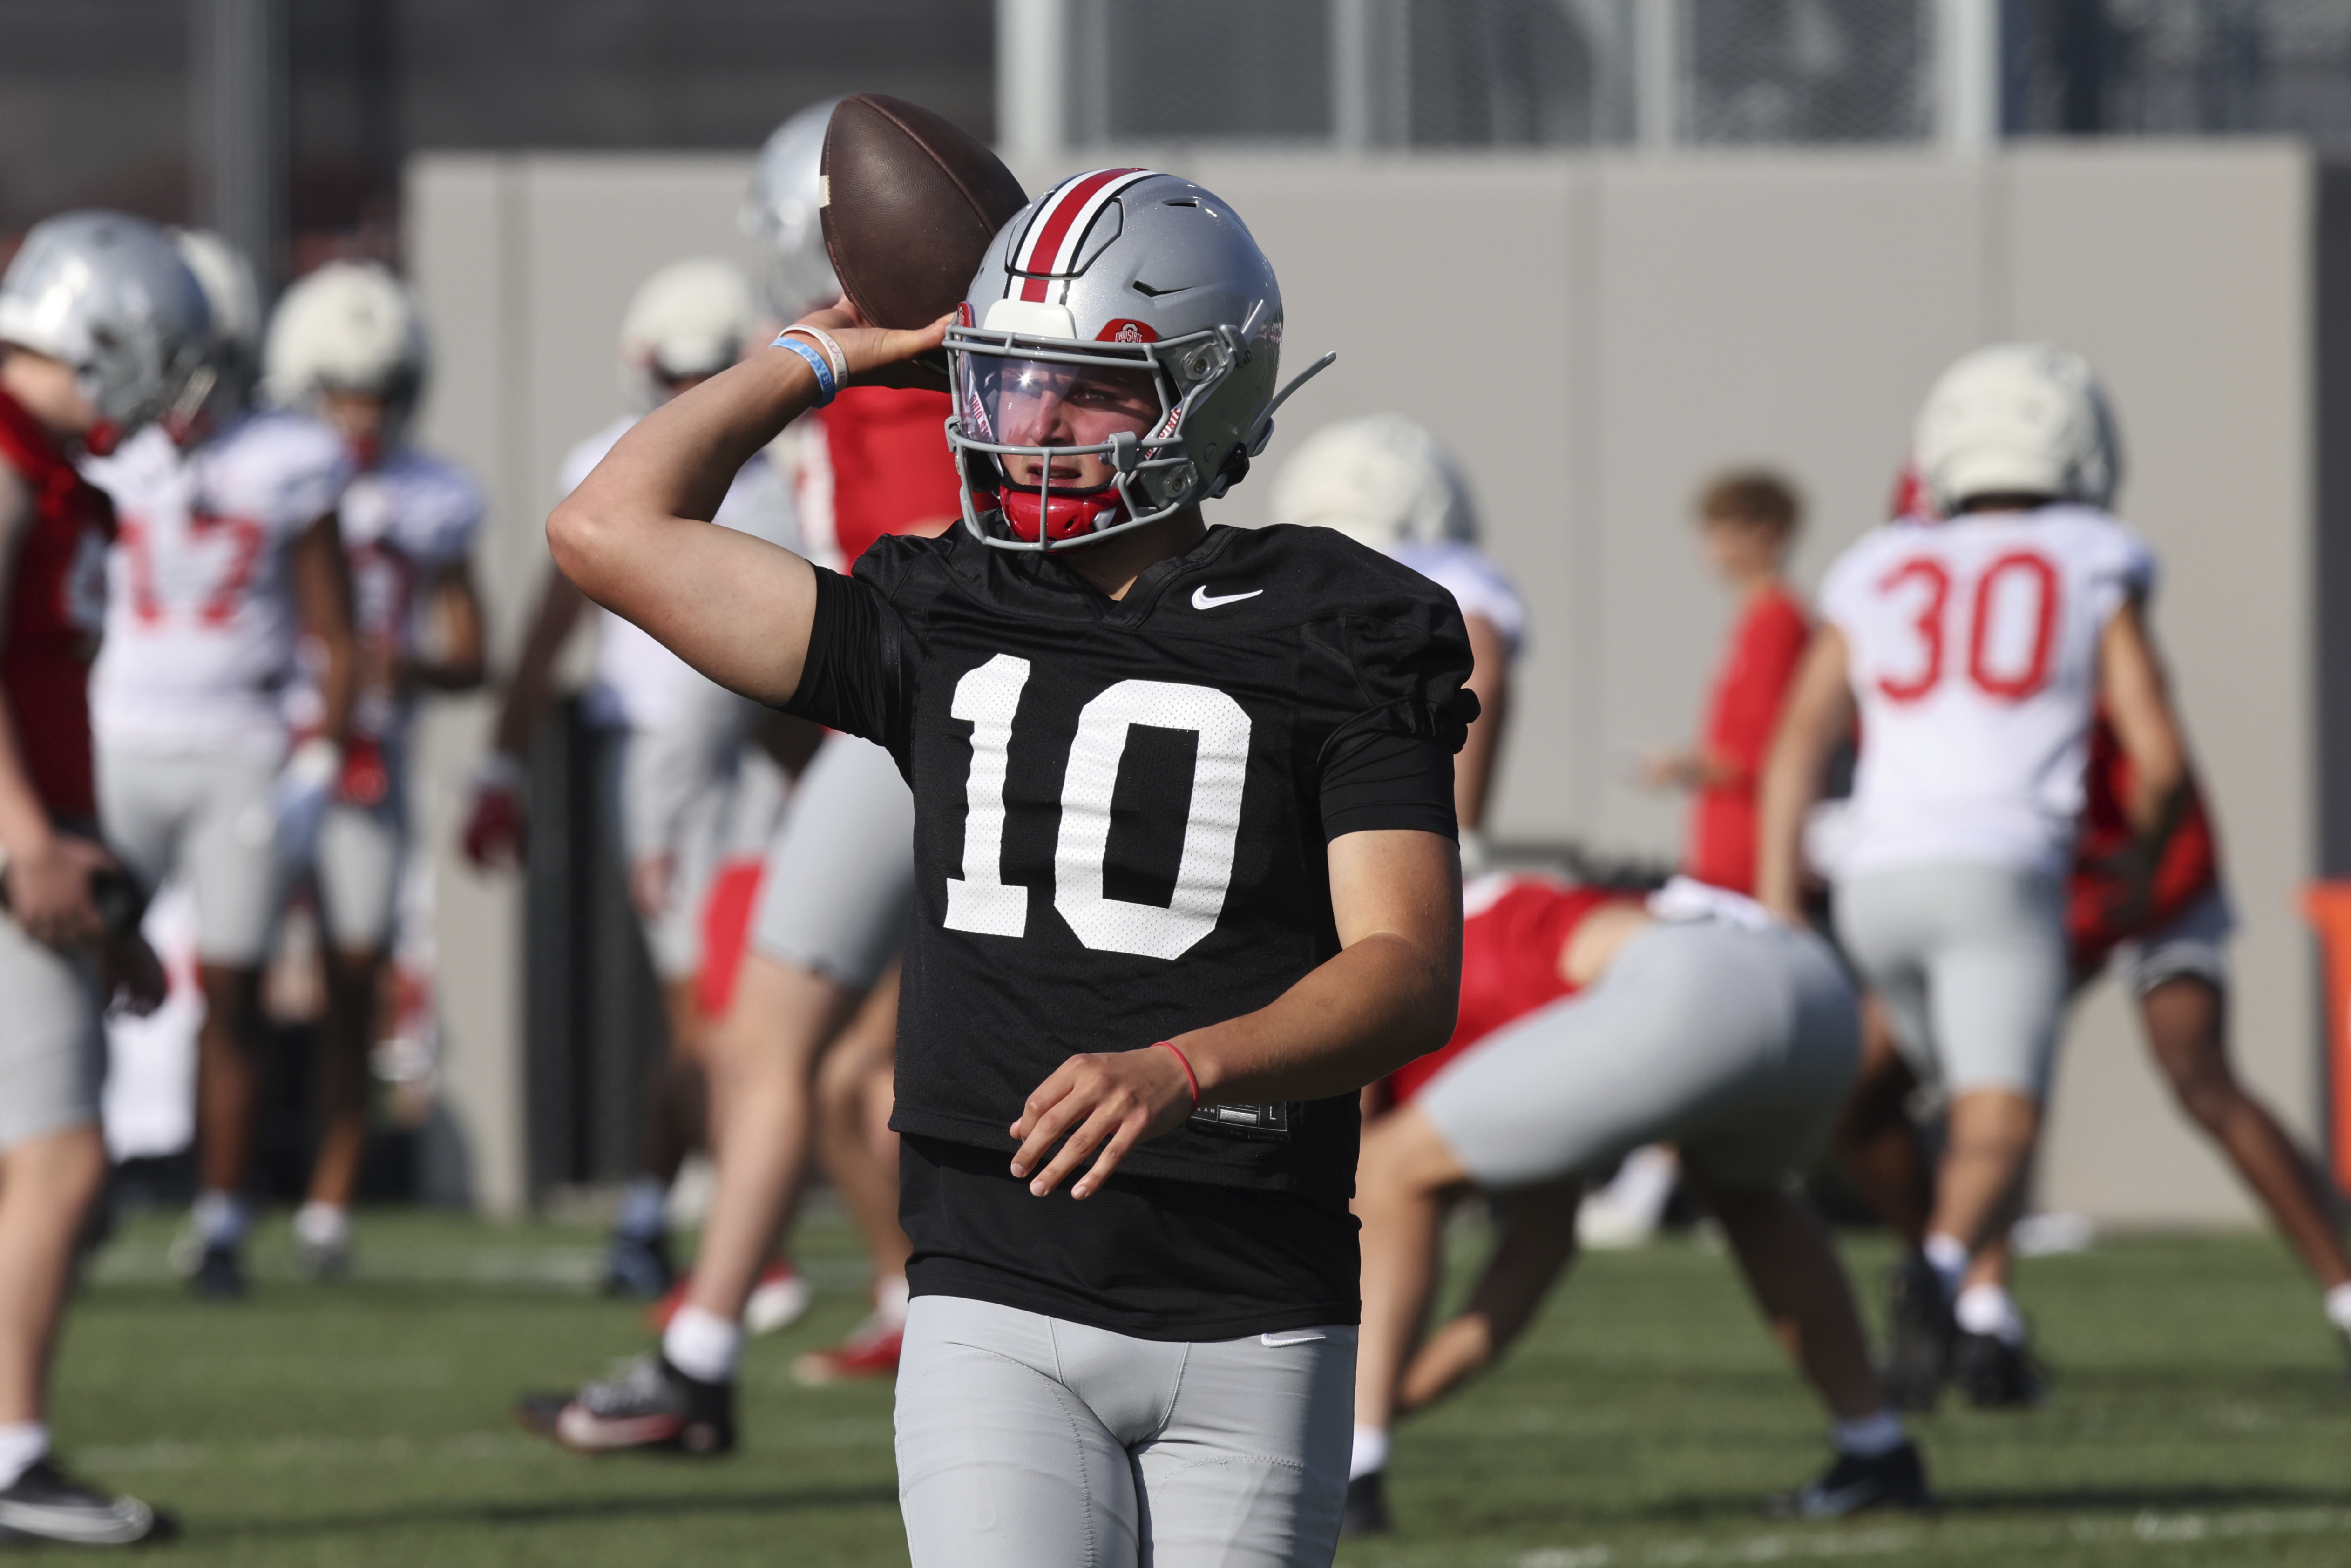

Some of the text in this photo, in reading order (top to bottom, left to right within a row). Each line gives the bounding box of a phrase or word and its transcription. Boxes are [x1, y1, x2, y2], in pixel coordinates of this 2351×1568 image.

[969, 394, 983, 419] OHIO
[116, 513, 268, 629] 17
[1876, 552, 2060, 702] 30
[943, 653, 1252, 961] 10
[1269, 1106, 1276, 1120] L
